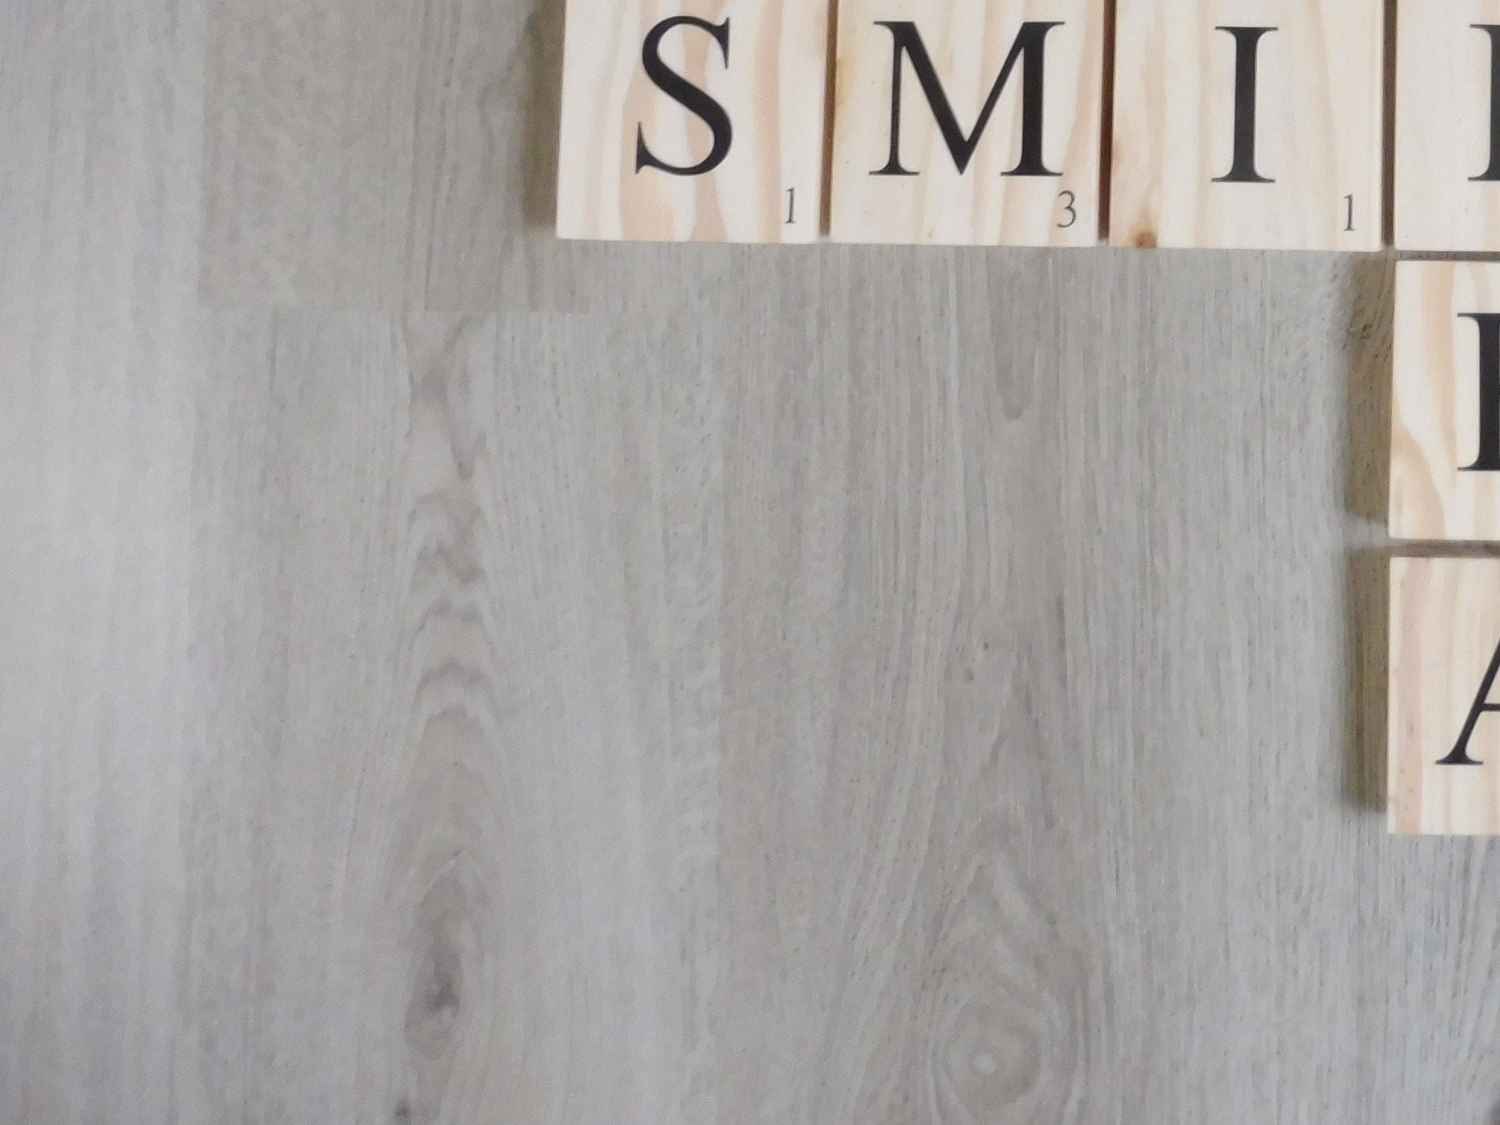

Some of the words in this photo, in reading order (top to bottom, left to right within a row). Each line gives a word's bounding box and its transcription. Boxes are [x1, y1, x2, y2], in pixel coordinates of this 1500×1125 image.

[784, 187, 796, 225] 1
[1055, 189, 1079, 229] 3
[1343, 193, 1356, 232] 1
